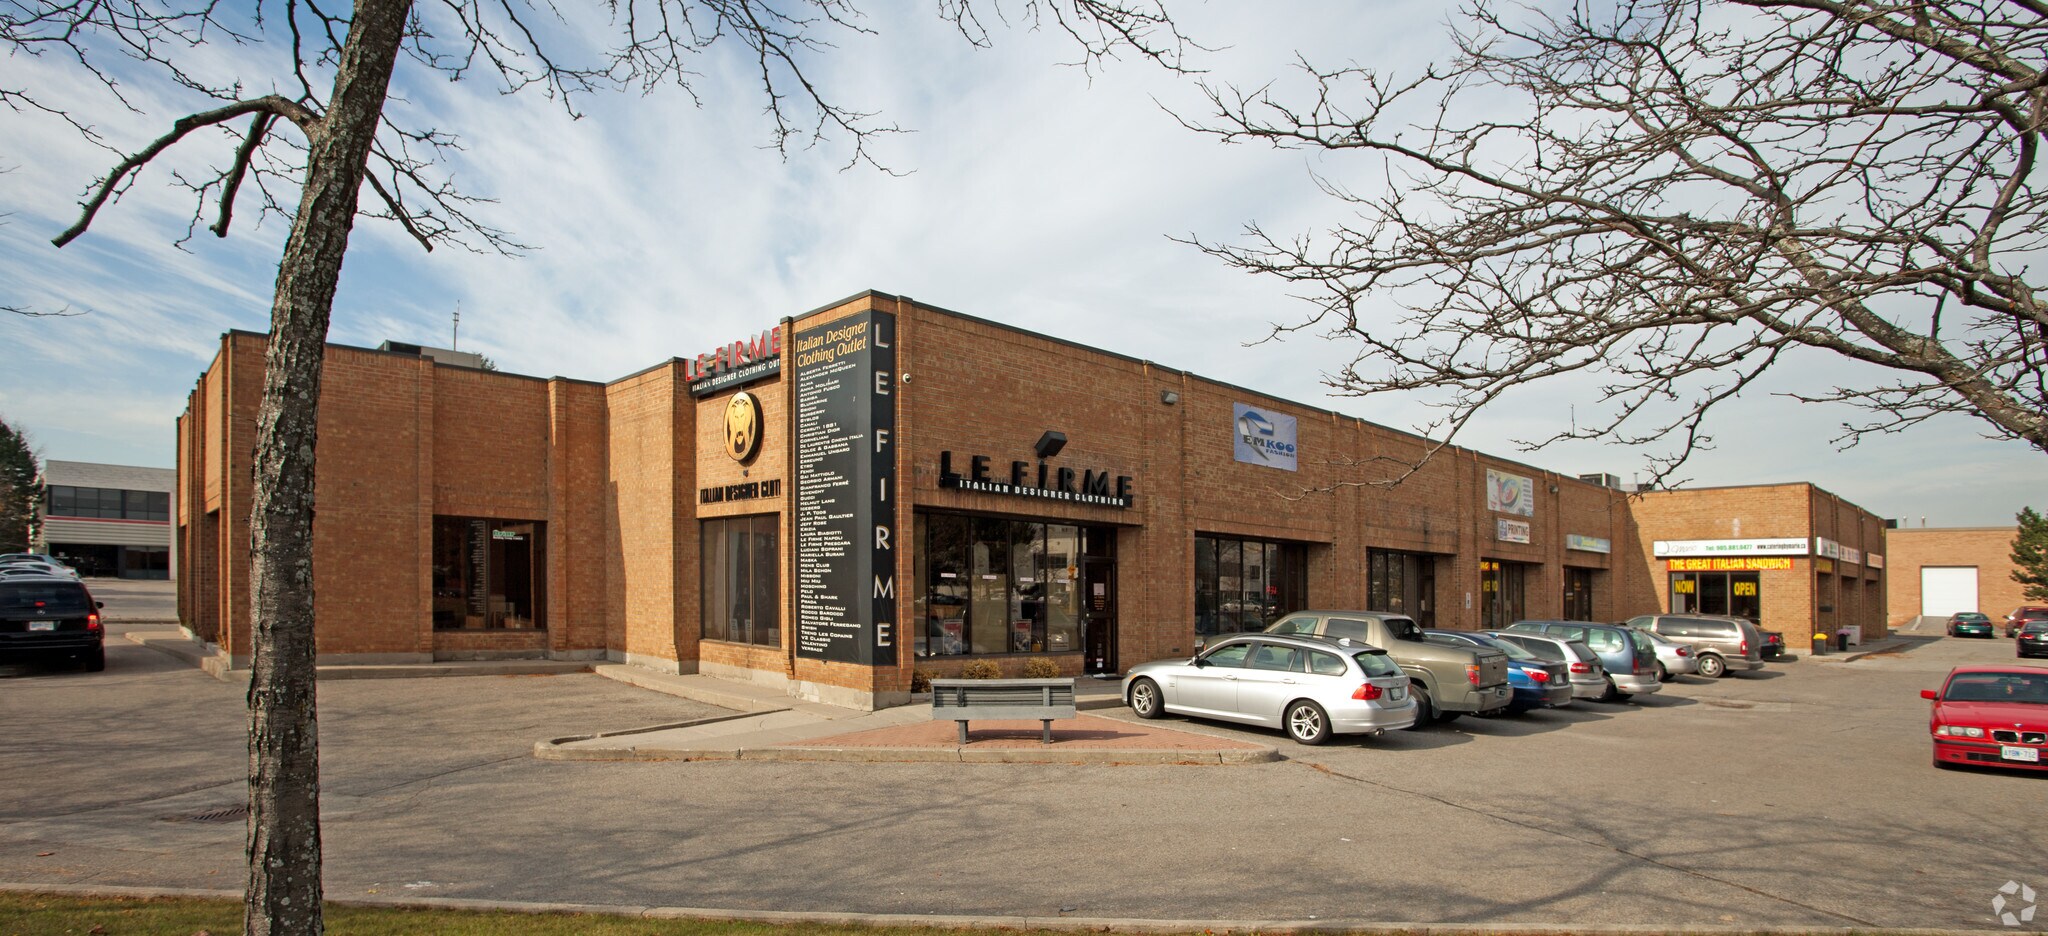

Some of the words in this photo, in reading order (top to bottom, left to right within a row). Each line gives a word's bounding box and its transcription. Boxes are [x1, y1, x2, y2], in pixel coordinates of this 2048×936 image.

[796, 335, 824, 352] Italian
[826, 321, 868, 344] Designer
[686, 353, 709, 382] LE
[716, 326, 780, 373] FIRME
[798, 348, 834, 367] Clothing
[836, 336, 866, 356] Outlet
[800, 368, 821, 376] ALBERTA
[823, 361, 846, 370] FERRETTI
[800, 371, 828, 381] ALEXANDER
[692, 381, 711, 392] ITALIAN
[712, 372, 737, 386] DESIGNER
[738, 363, 766, 378] CLOTHING
[800, 389, 822, 397] ANTONIO
[800, 398, 827, 407] BLUMARINE
[800, 409, 826, 418] BURBERRY
[800, 435, 829, 443] CORNELIANI
[1243, 435, 1294, 452] EMKOO
[1266, 449, 1294, 458] FASHION
[941, 451, 991, 482] LE
[1012, 461, 1134, 498] FIRME
[700, 487, 723, 504] ITALIAN
[725, 482, 758, 501] DESIGNER
[960, 480, 1008, 493] ITALIAN
[1015, 486, 1070, 500] DESIGNER
[1075, 493, 1124, 506] CLOTHING
[873, 428, 894, 647] FIRME
[1508, 524, 1528, 536] PRINTING
[1669, 559, 1685, 570] THE
[1686, 559, 1711, 570] GREAT
[1713, 558, 1744, 570] ITALIAN
[1746, 558, 1790, 569] SANDWICH
[1675, 580, 1695, 593] NOW
[1734, 582, 1756, 596] OPEN
